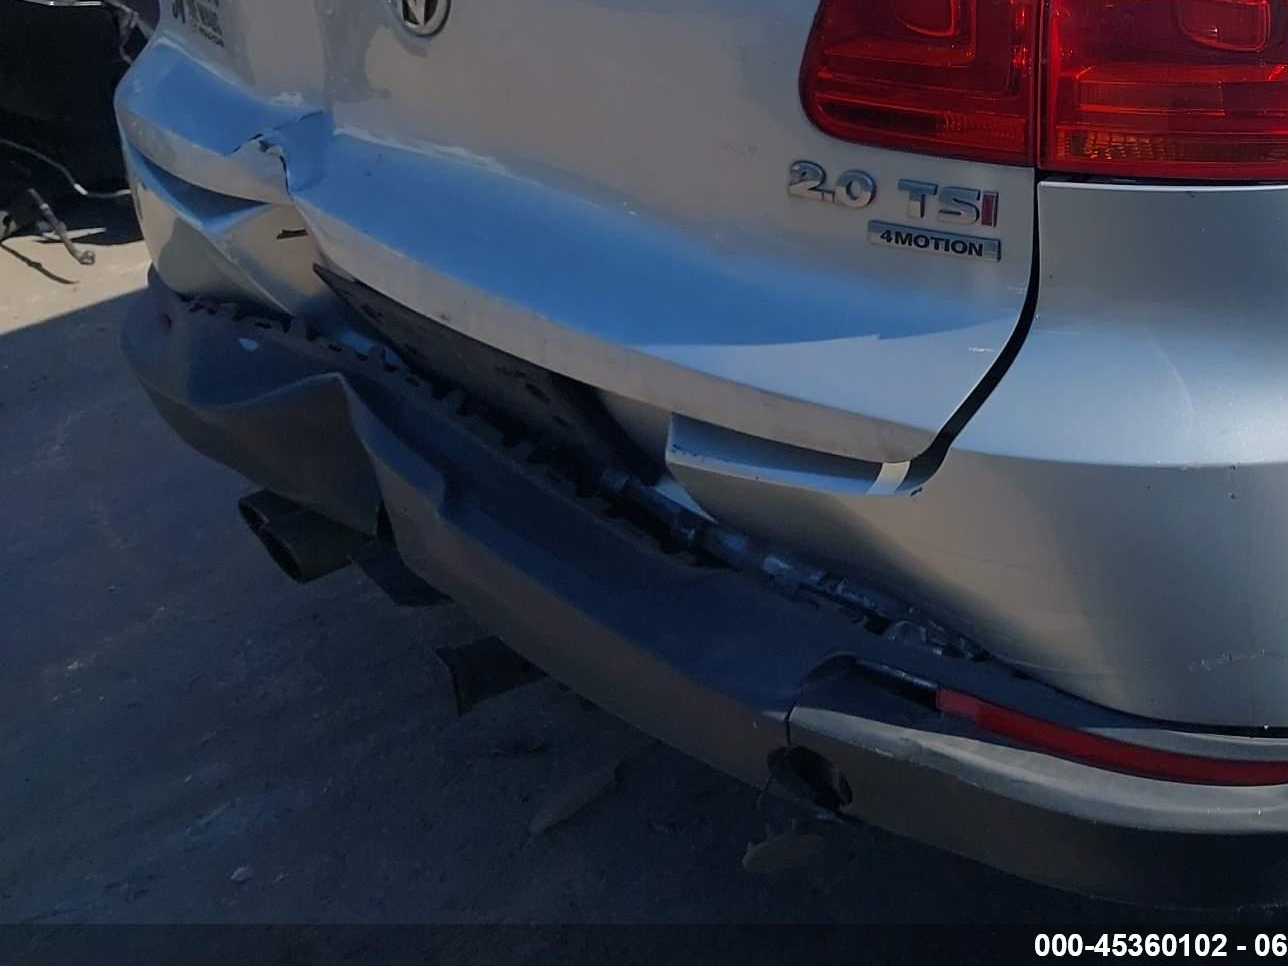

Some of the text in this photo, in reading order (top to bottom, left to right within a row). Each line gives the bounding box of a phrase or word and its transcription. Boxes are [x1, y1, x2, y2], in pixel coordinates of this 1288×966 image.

[788, 160, 999, 228] 2.0 TSI
[880, 229, 984, 257] 4MOTION
